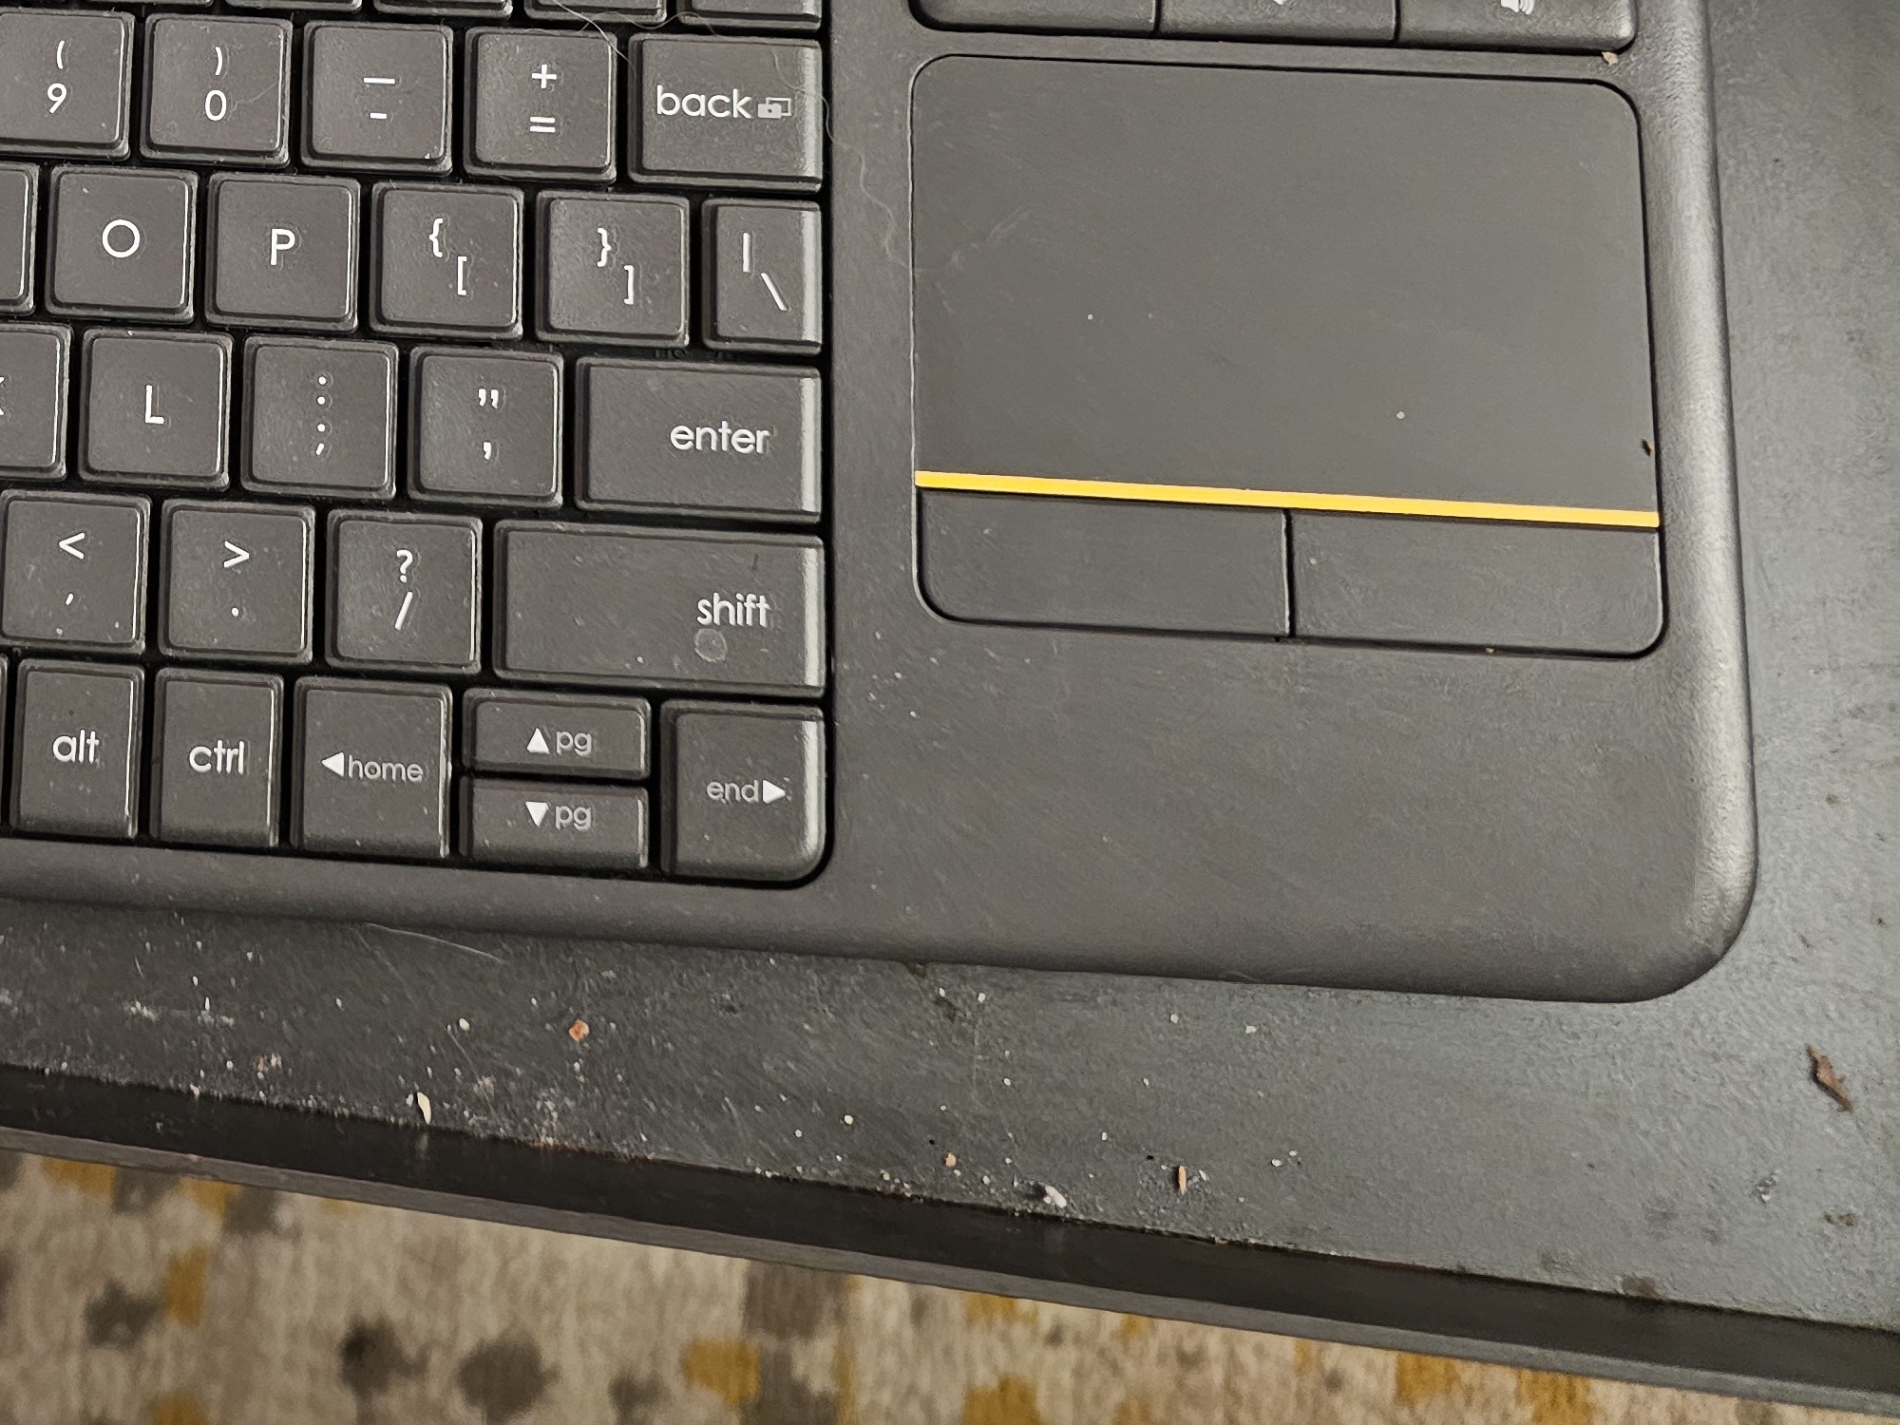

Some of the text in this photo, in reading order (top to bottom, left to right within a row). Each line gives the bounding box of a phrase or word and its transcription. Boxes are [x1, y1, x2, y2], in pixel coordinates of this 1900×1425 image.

[56, 40, 65, 70] (
[215, 46, 224, 76] )
[531, 63, 558, 89] +
[46, 82, 68, 114] 9
[204, 89, 227, 122] 0
[656, 84, 754, 120] back
[529, 116, 556, 133] =
[101, 218, 141, 259] O
[270, 228, 296, 266] P
[428, 217, 445, 258] {
[597, 227, 612, 268] }
[457, 256, 469, 297] [
[624, 265, 636, 306] ]
[761, 272, 787, 312] \
[144, 384, 165, 425] L
[317, 376, 327, 405] :
[315, 423, 326, 456] ;
[670, 420, 770, 454] enter
[58, 532, 86, 560] <
[223, 540, 250, 568] >
[396, 549, 414, 583] ?
[394, 591, 414, 630] /
[696, 592, 771, 628] shift
[52, 729, 100, 764] alt
[189, 739, 245, 775] ctrl
[555, 730, 593, 757] pg
[347, 752, 424, 782] home
[706, 779, 760, 804] end
[555, 805, 592, 831] pg
